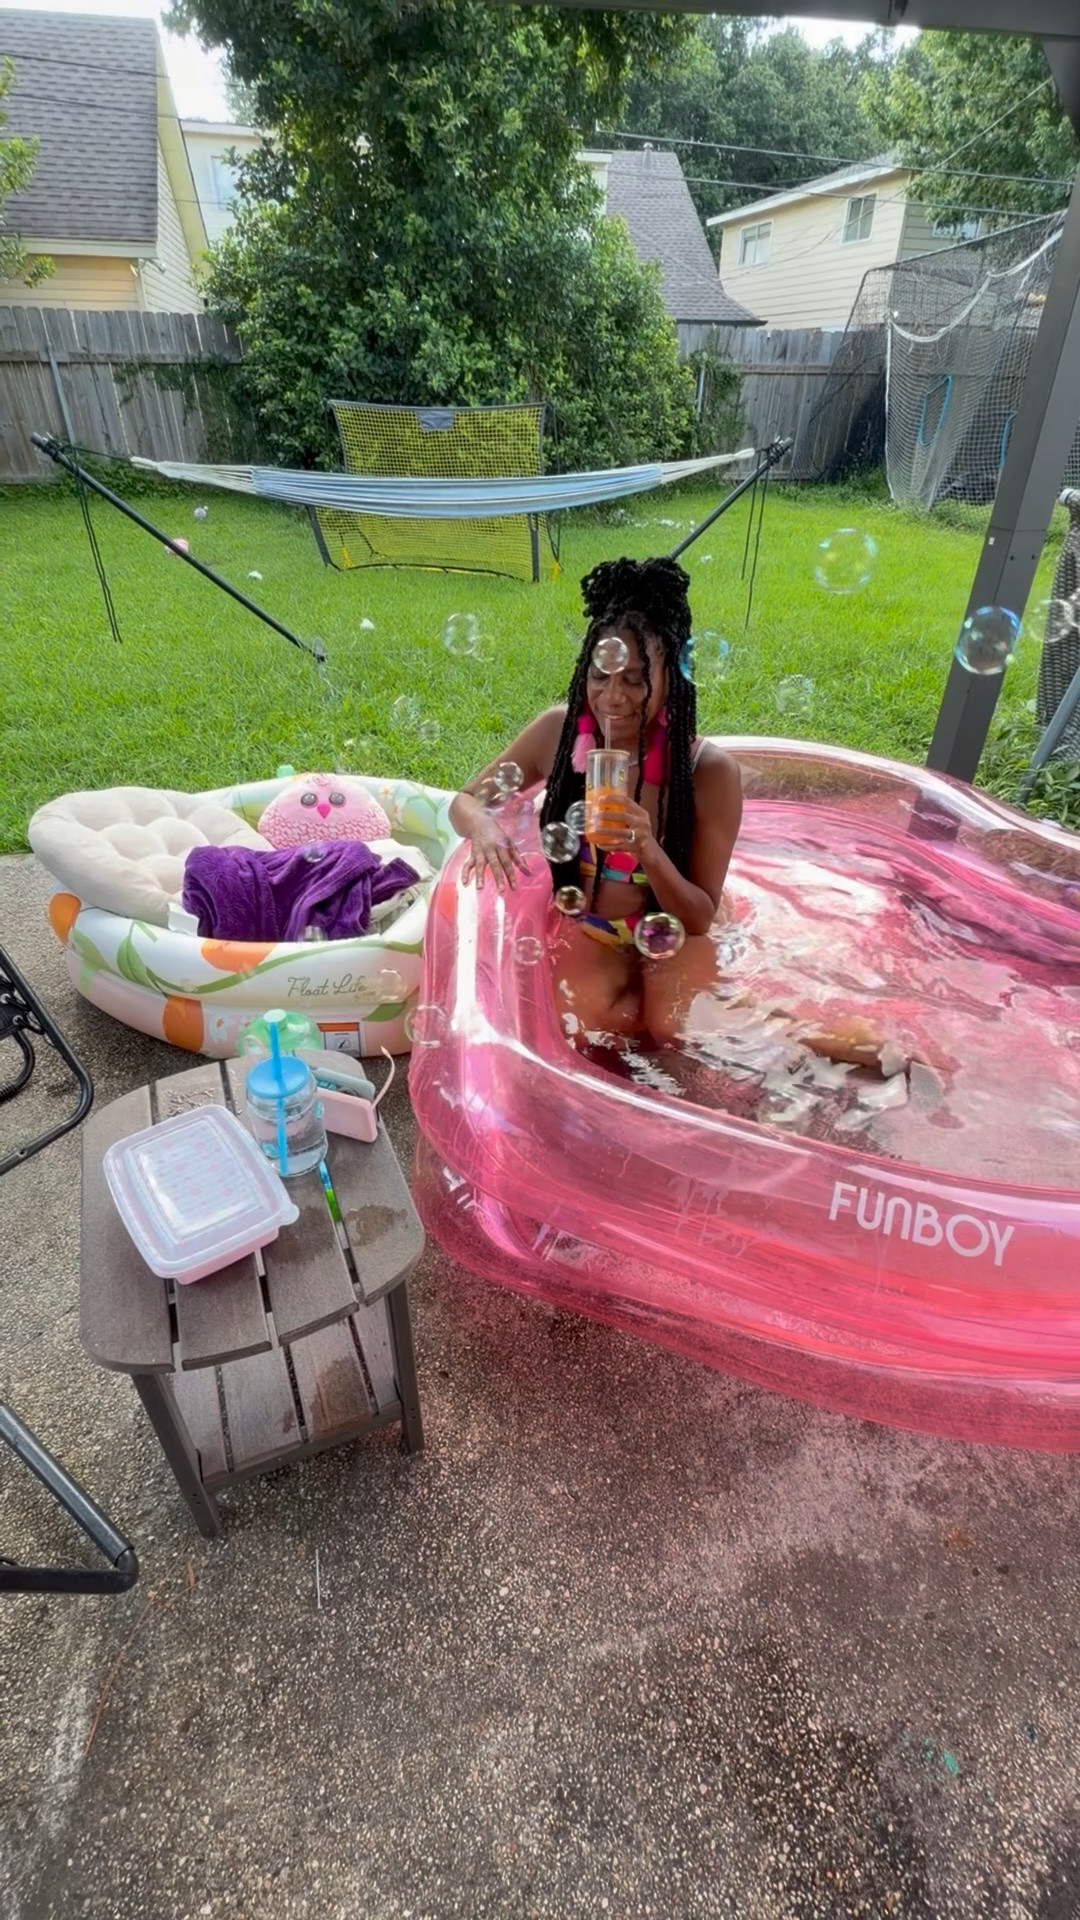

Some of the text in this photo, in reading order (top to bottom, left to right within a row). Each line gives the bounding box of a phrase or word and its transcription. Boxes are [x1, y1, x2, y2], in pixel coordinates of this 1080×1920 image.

[287, 973, 368, 998] Float Life
[828, 1181, 1015, 1266] FUNBOY
